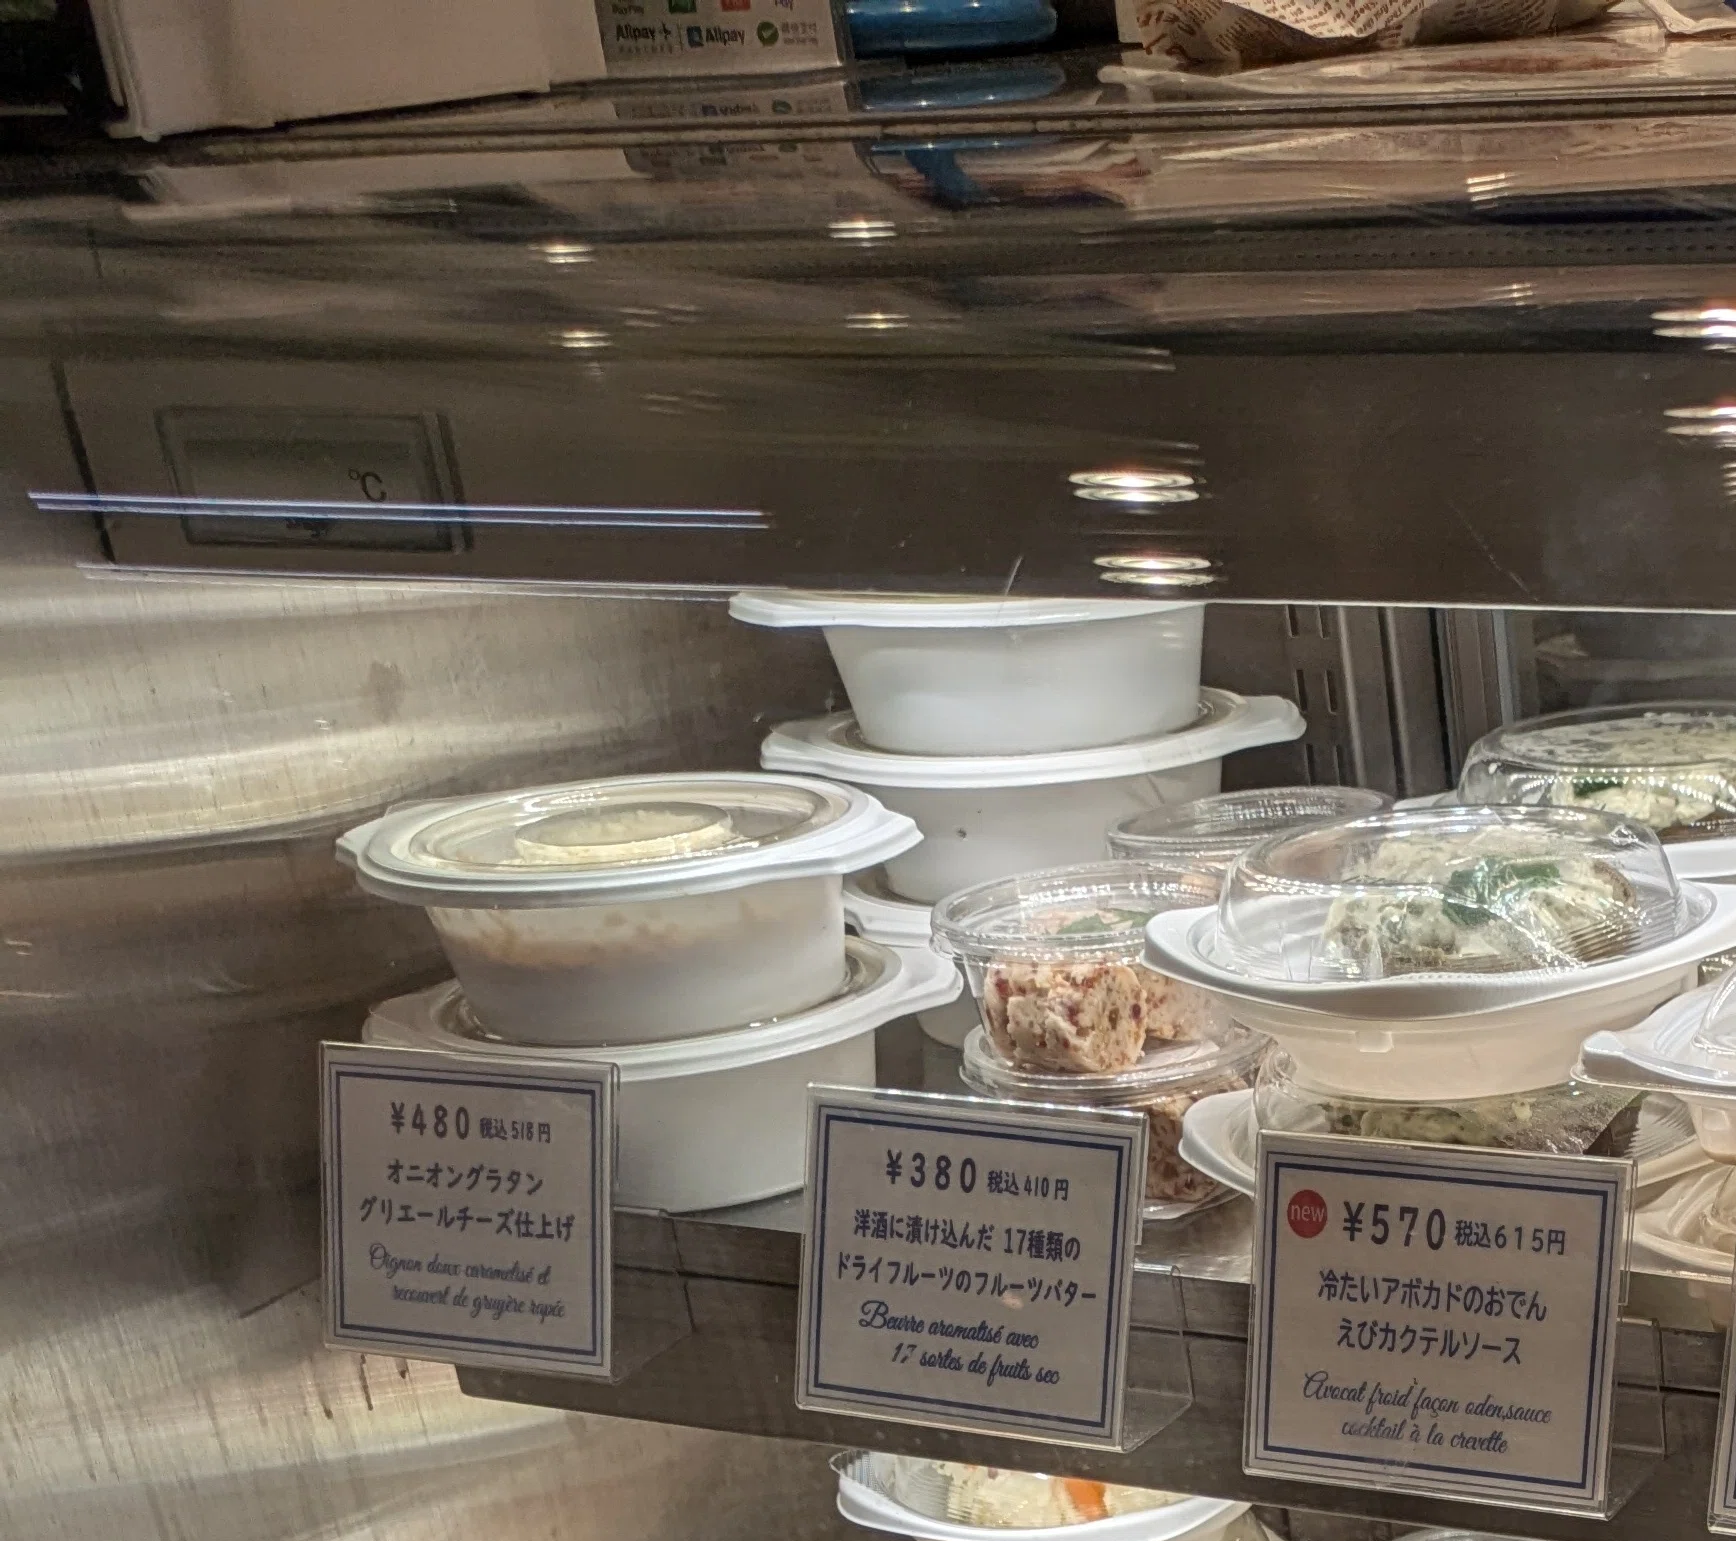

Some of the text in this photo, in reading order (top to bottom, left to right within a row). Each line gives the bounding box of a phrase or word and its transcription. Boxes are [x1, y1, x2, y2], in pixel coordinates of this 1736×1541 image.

[391, 1101, 470, 1140] ¥480
[388, 1159, 543, 1195] オニオングラタン
[886, 1149, 976, 1193] ¥380
[360, 1196, 576, 1242] グリエールチーズ仕上げ
[1290, 1203, 1325, 1221] new
[1343, 1201, 1446, 1251] ¥570
[838, 1252, 1096, 1307] ドライフルーツのフルーツバター
[1318, 1270, 1547, 1322] 冷たいアボカドのおでん
[859, 1301, 1039, 1349] Beurre aromatisé avec
[1337, 1318, 1521, 1365] えびカクテルソース
[920, 1350, 964, 1372] sortes
[968, 1352, 986, 1375] de
[987, 1354, 1032, 1387] fruits
[1303, 1371, 1459, 1420] Avocat froid façon
[1410, 1424, 1421, 1443] à
[1426, 1423, 1444, 1445] la
[1450, 1431, 1508, 1453] crevette
